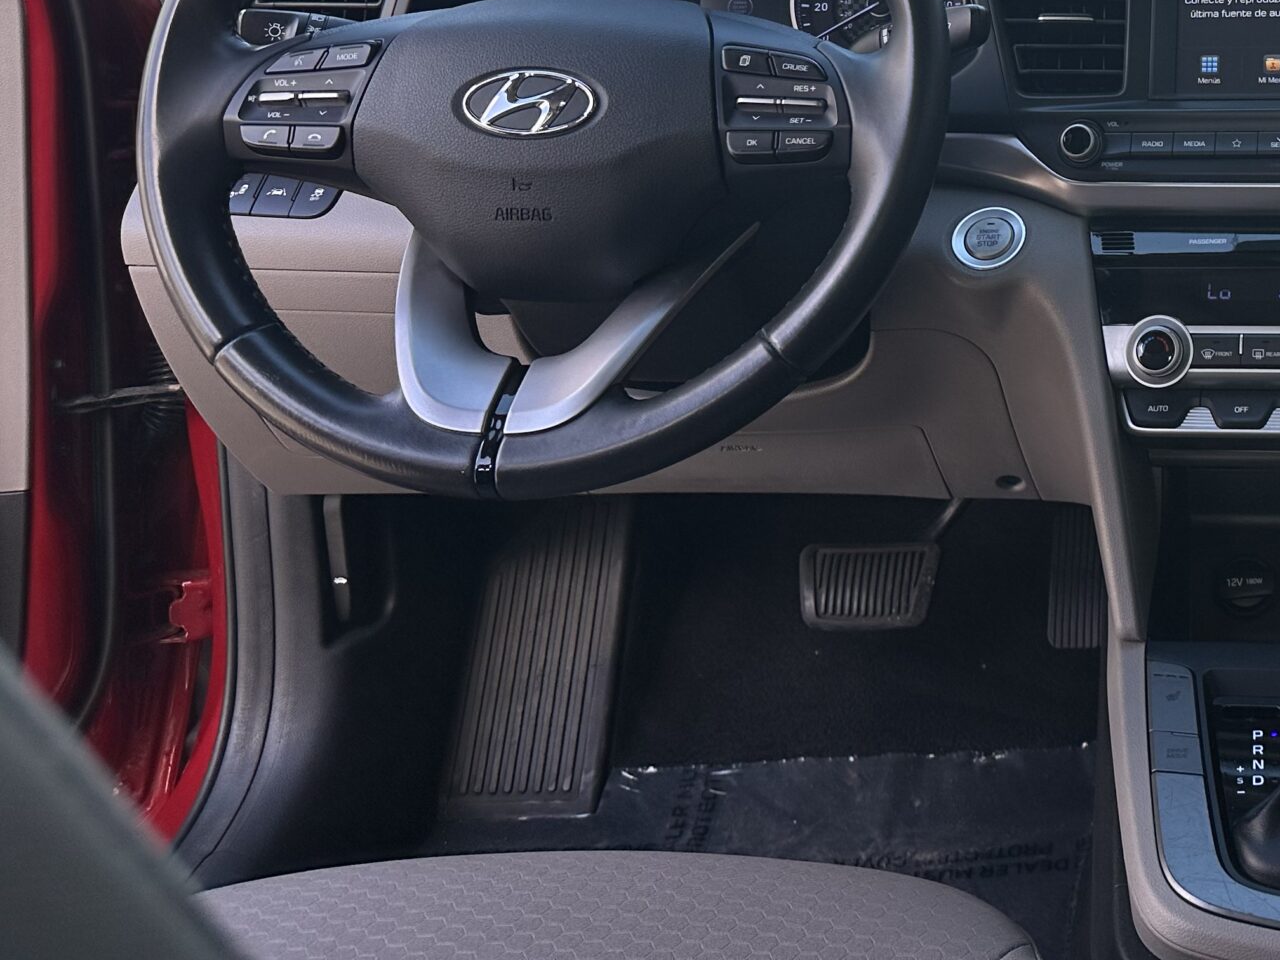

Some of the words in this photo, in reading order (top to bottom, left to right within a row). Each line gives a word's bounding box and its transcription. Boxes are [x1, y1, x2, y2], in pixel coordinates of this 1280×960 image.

[814, 2, 829, 12] 20
[1190, 10, 1219, 19] última
[1221, 9, 1252, 18] fuente
[1254, 9, 1267, 17] de
[336, 52, 359, 61] MODE
[782, 62, 809, 72] CRUISE
[746, 138, 758, 147] OK
[785, 137, 817, 145] CANCEL
[494, 207, 553, 221] AIRBAG
[1226, 577, 1243, 587] 12V
[1252, 729, 1264, 740] P
[1252, 744, 1264, 755] R
[1252, 759, 1264, 770] N
[1236, 777, 1244, 785] S
[1252, 775, 1265, 786] D
